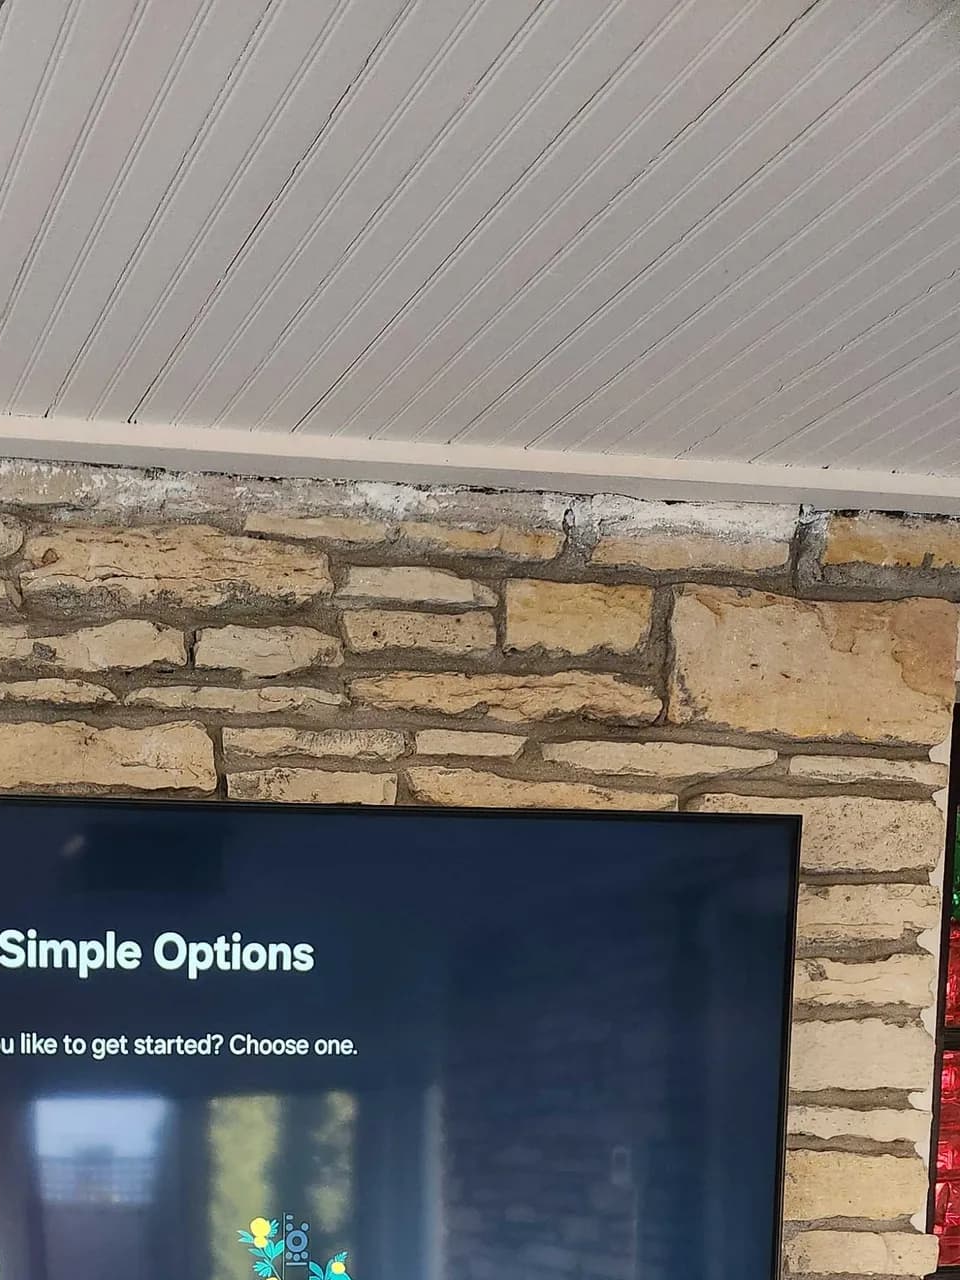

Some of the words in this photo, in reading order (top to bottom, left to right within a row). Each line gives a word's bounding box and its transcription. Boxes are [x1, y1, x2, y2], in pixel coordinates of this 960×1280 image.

[153, 932, 314, 980] Options
[20, 1032, 58, 1055] like
[62, 1034, 87, 1055] to
[91, 1035, 129, 1060] get
[134, 1033, 224, 1055] started?
[229, 1033, 310, 1056] Choose
[314, 1038, 358, 1055] one.
